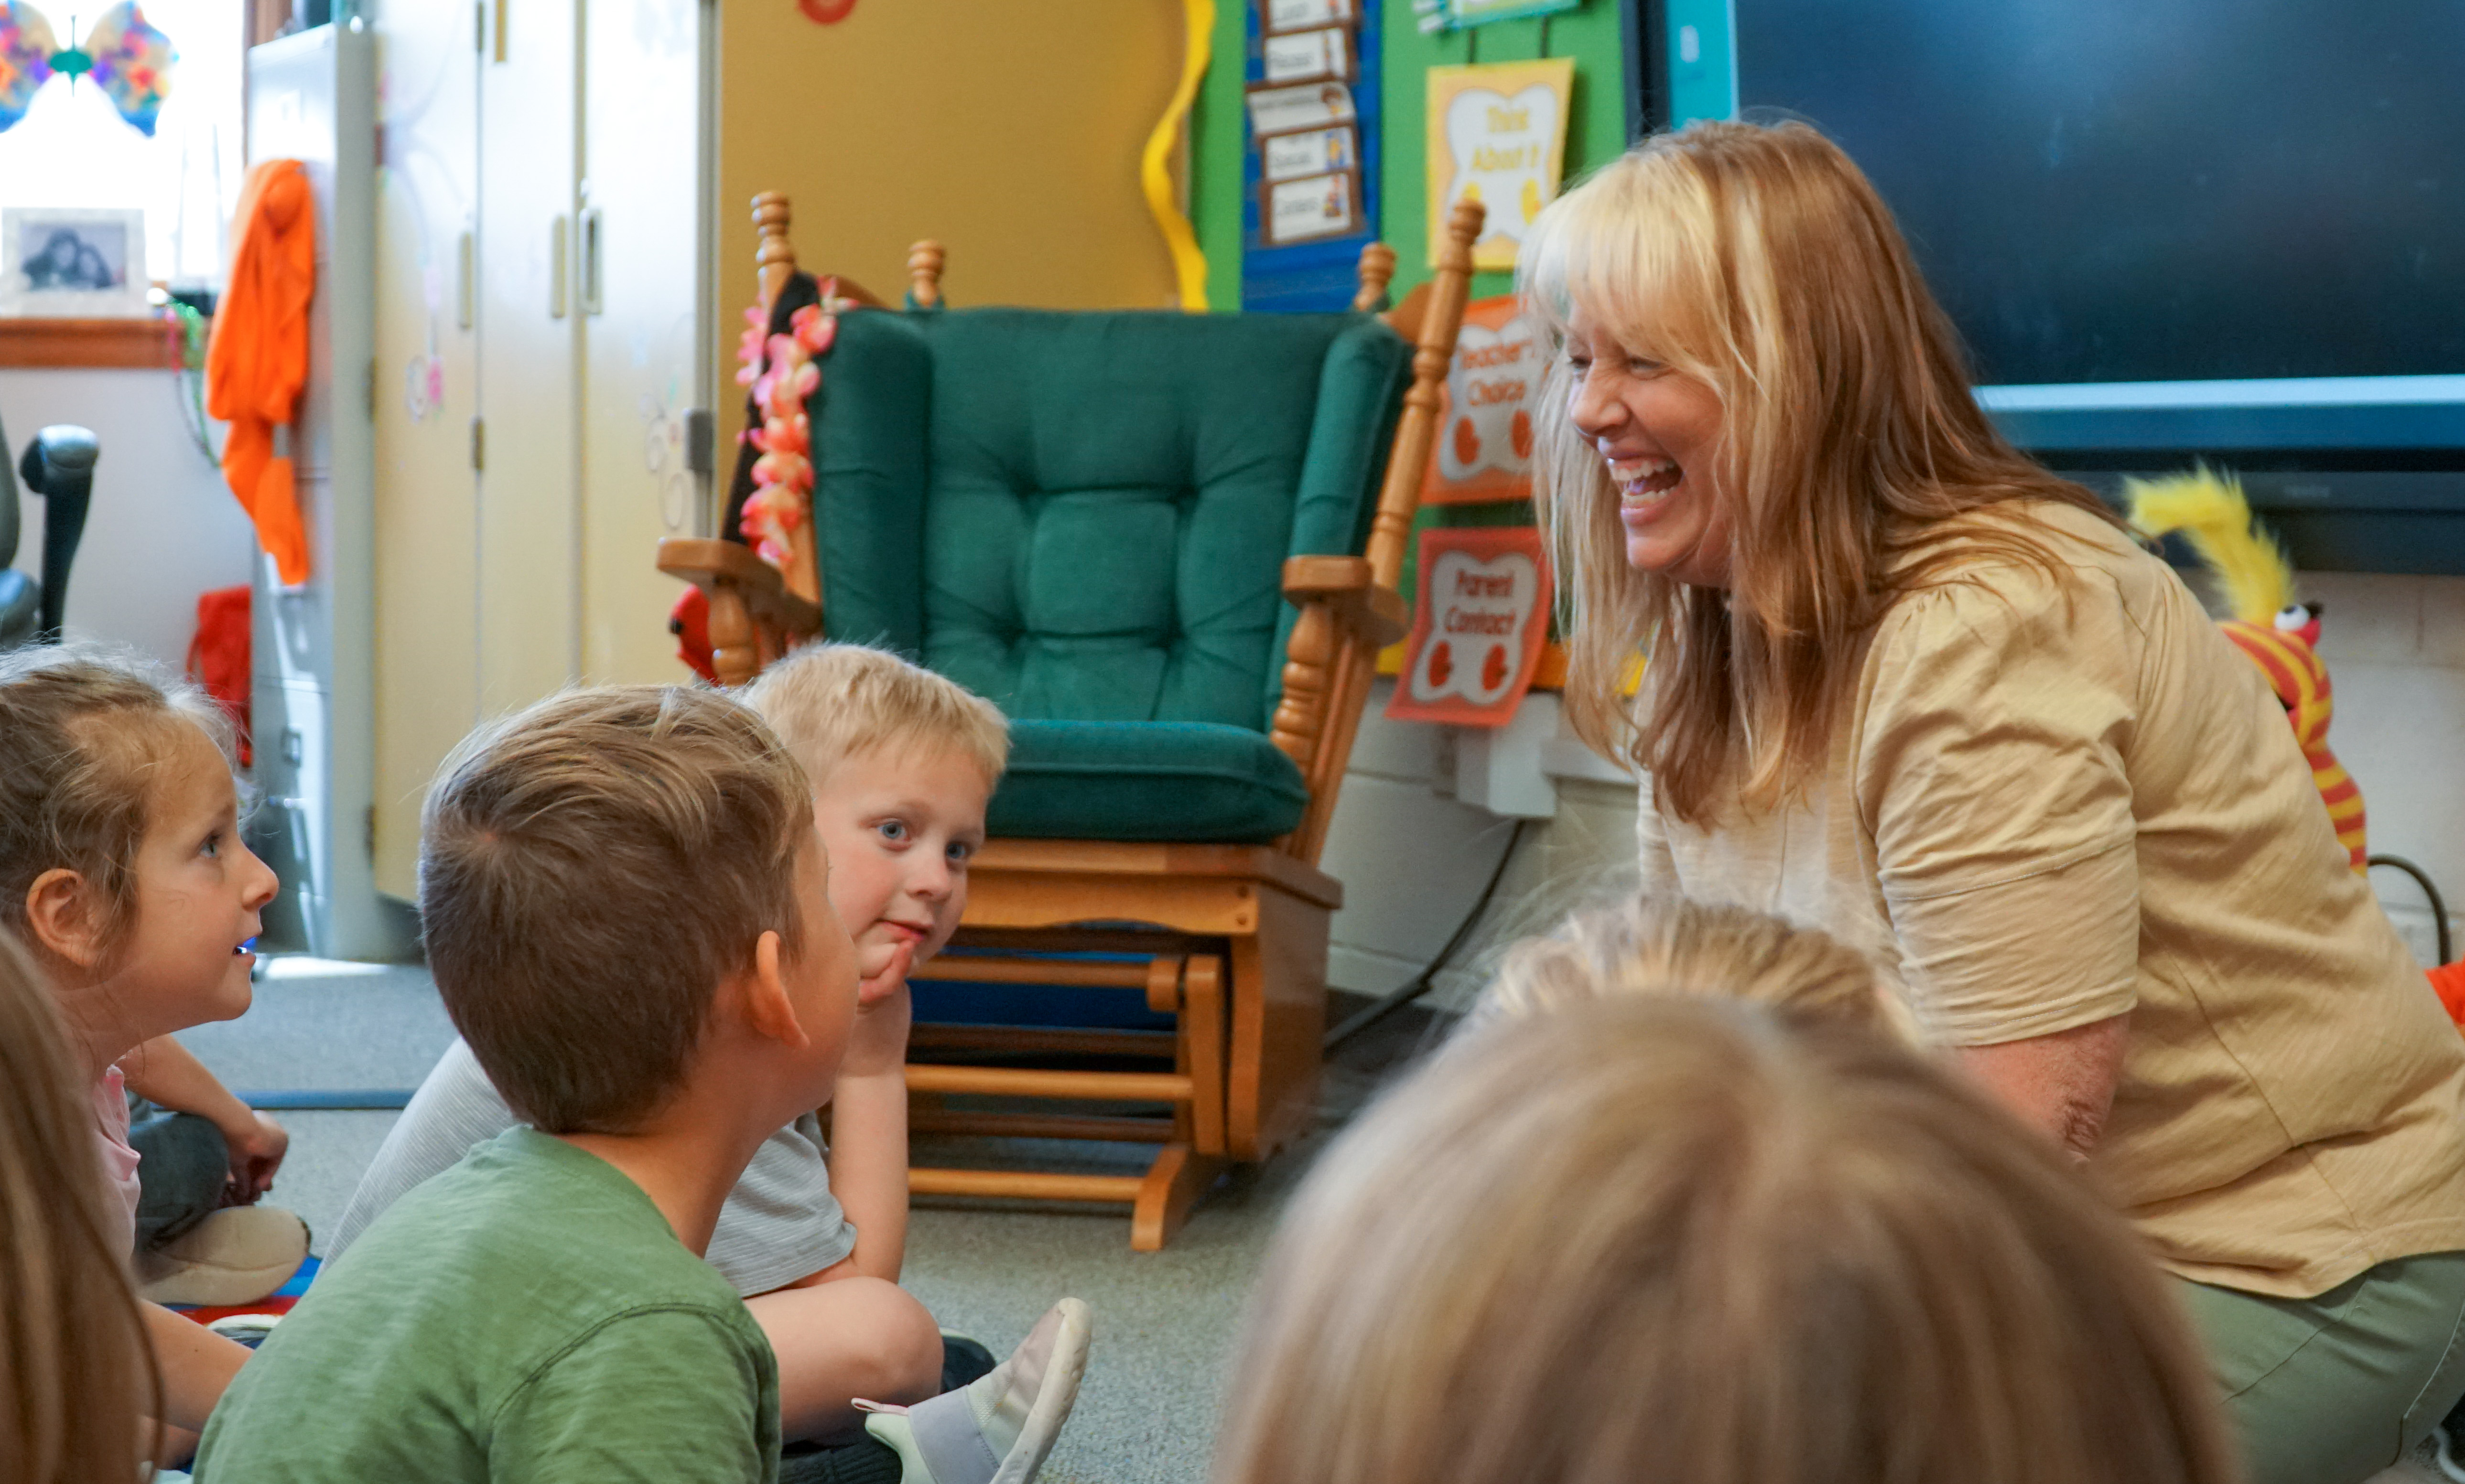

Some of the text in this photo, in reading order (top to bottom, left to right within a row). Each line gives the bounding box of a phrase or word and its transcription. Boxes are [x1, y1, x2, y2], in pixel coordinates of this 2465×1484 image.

[1472, 145, 1524, 171] About
[1468, 379, 1527, 407] Choice
[1456, 569, 1515, 596] Parent
[1444, 606, 1516, 634] Contact
